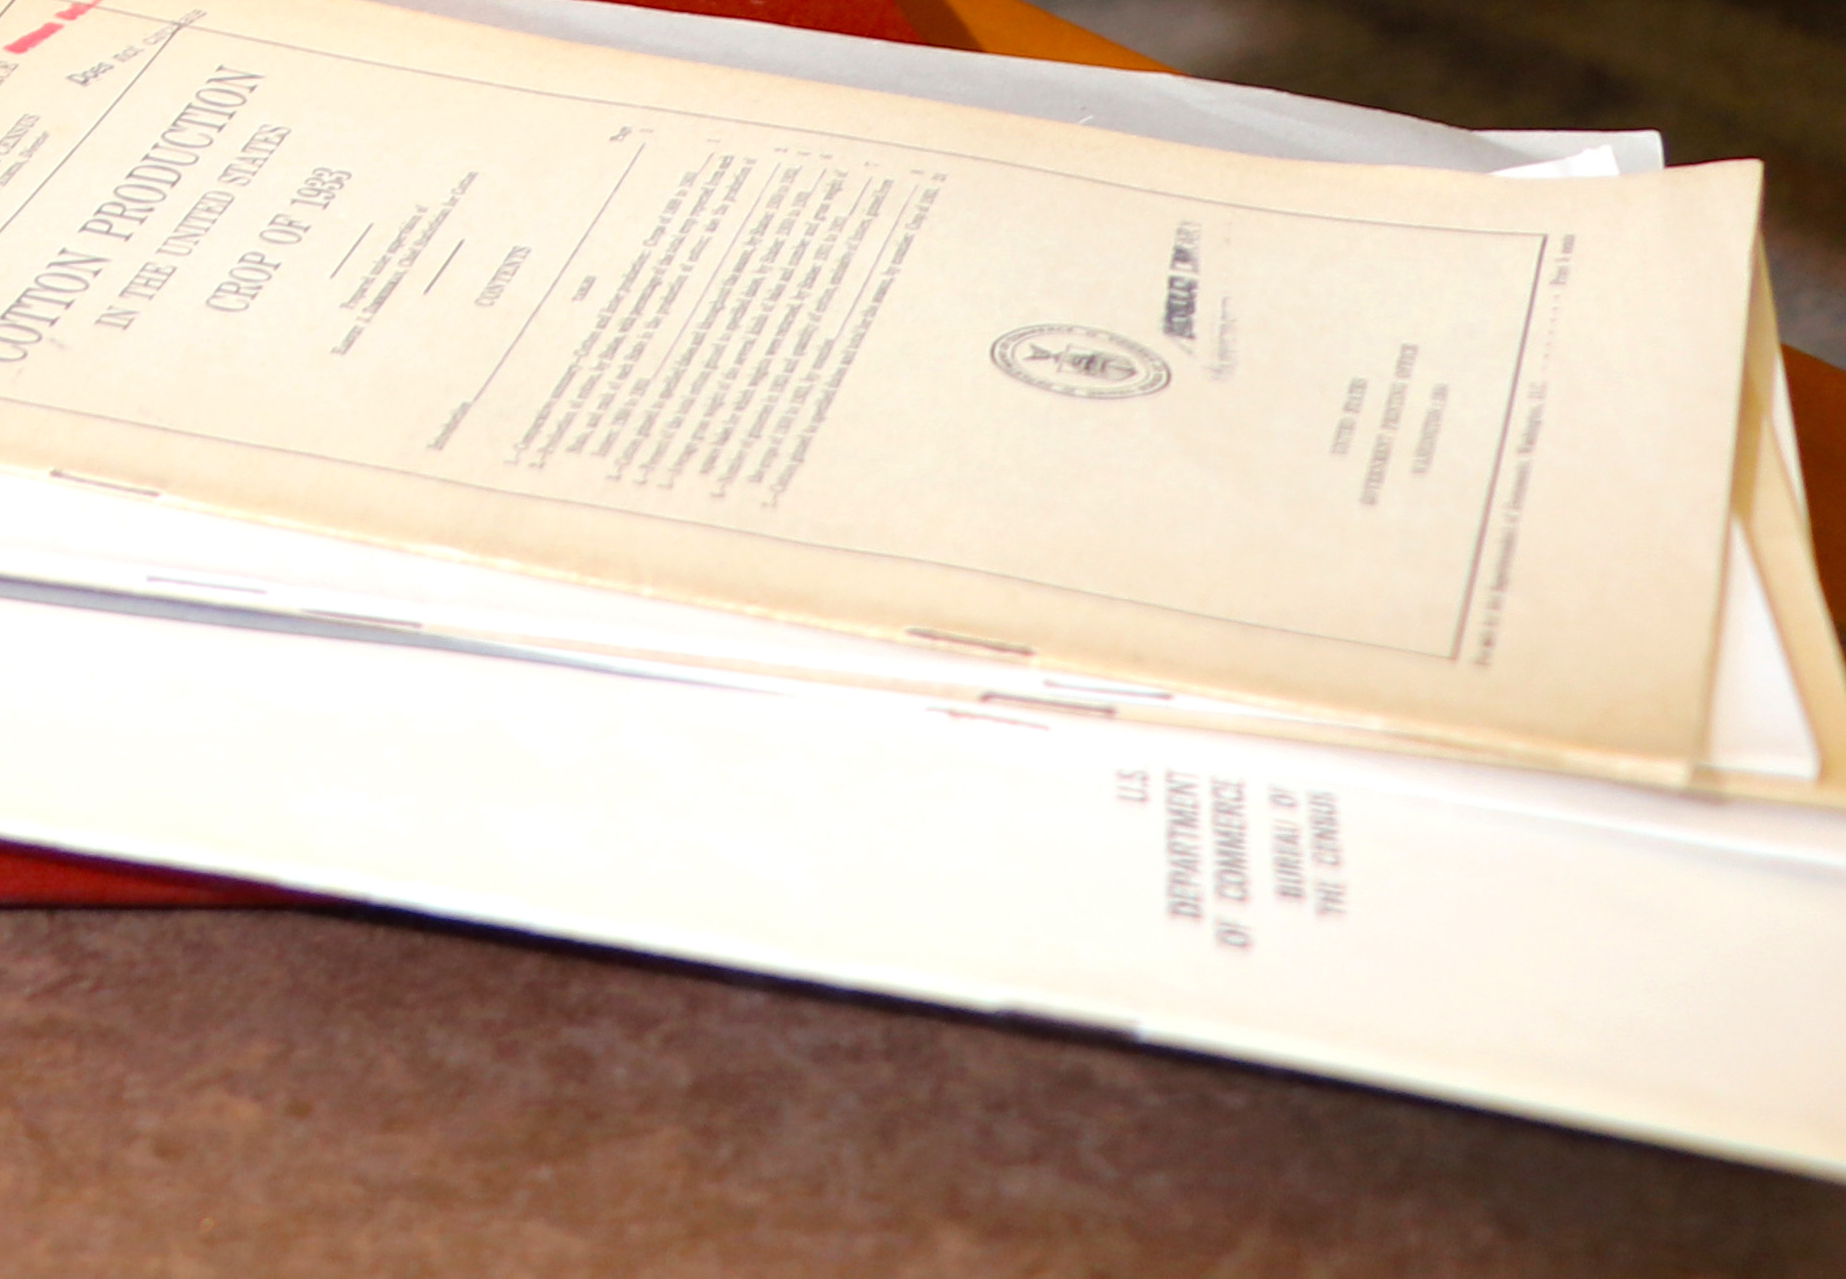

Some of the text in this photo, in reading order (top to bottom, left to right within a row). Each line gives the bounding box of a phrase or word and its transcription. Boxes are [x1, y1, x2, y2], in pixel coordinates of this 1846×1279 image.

[66, 59, 114, 87] Does
[112, 41, 142, 64] not
[74, 61, 270, 244] PRODUCTION
[91, 121, 295, 330] IN THE UNITED STATES
[198, 164, 356, 315] CROP OF 1933
[472, 243, 533, 308] CONTENTS
[1164, 767, 1205, 923] DEPARTMENT
[1211, 776, 1255, 953] OF COMMERCE
[1270, 816, 1307, 904] BUREAU
[1306, 788, 1350, 922] THE CENSUS
